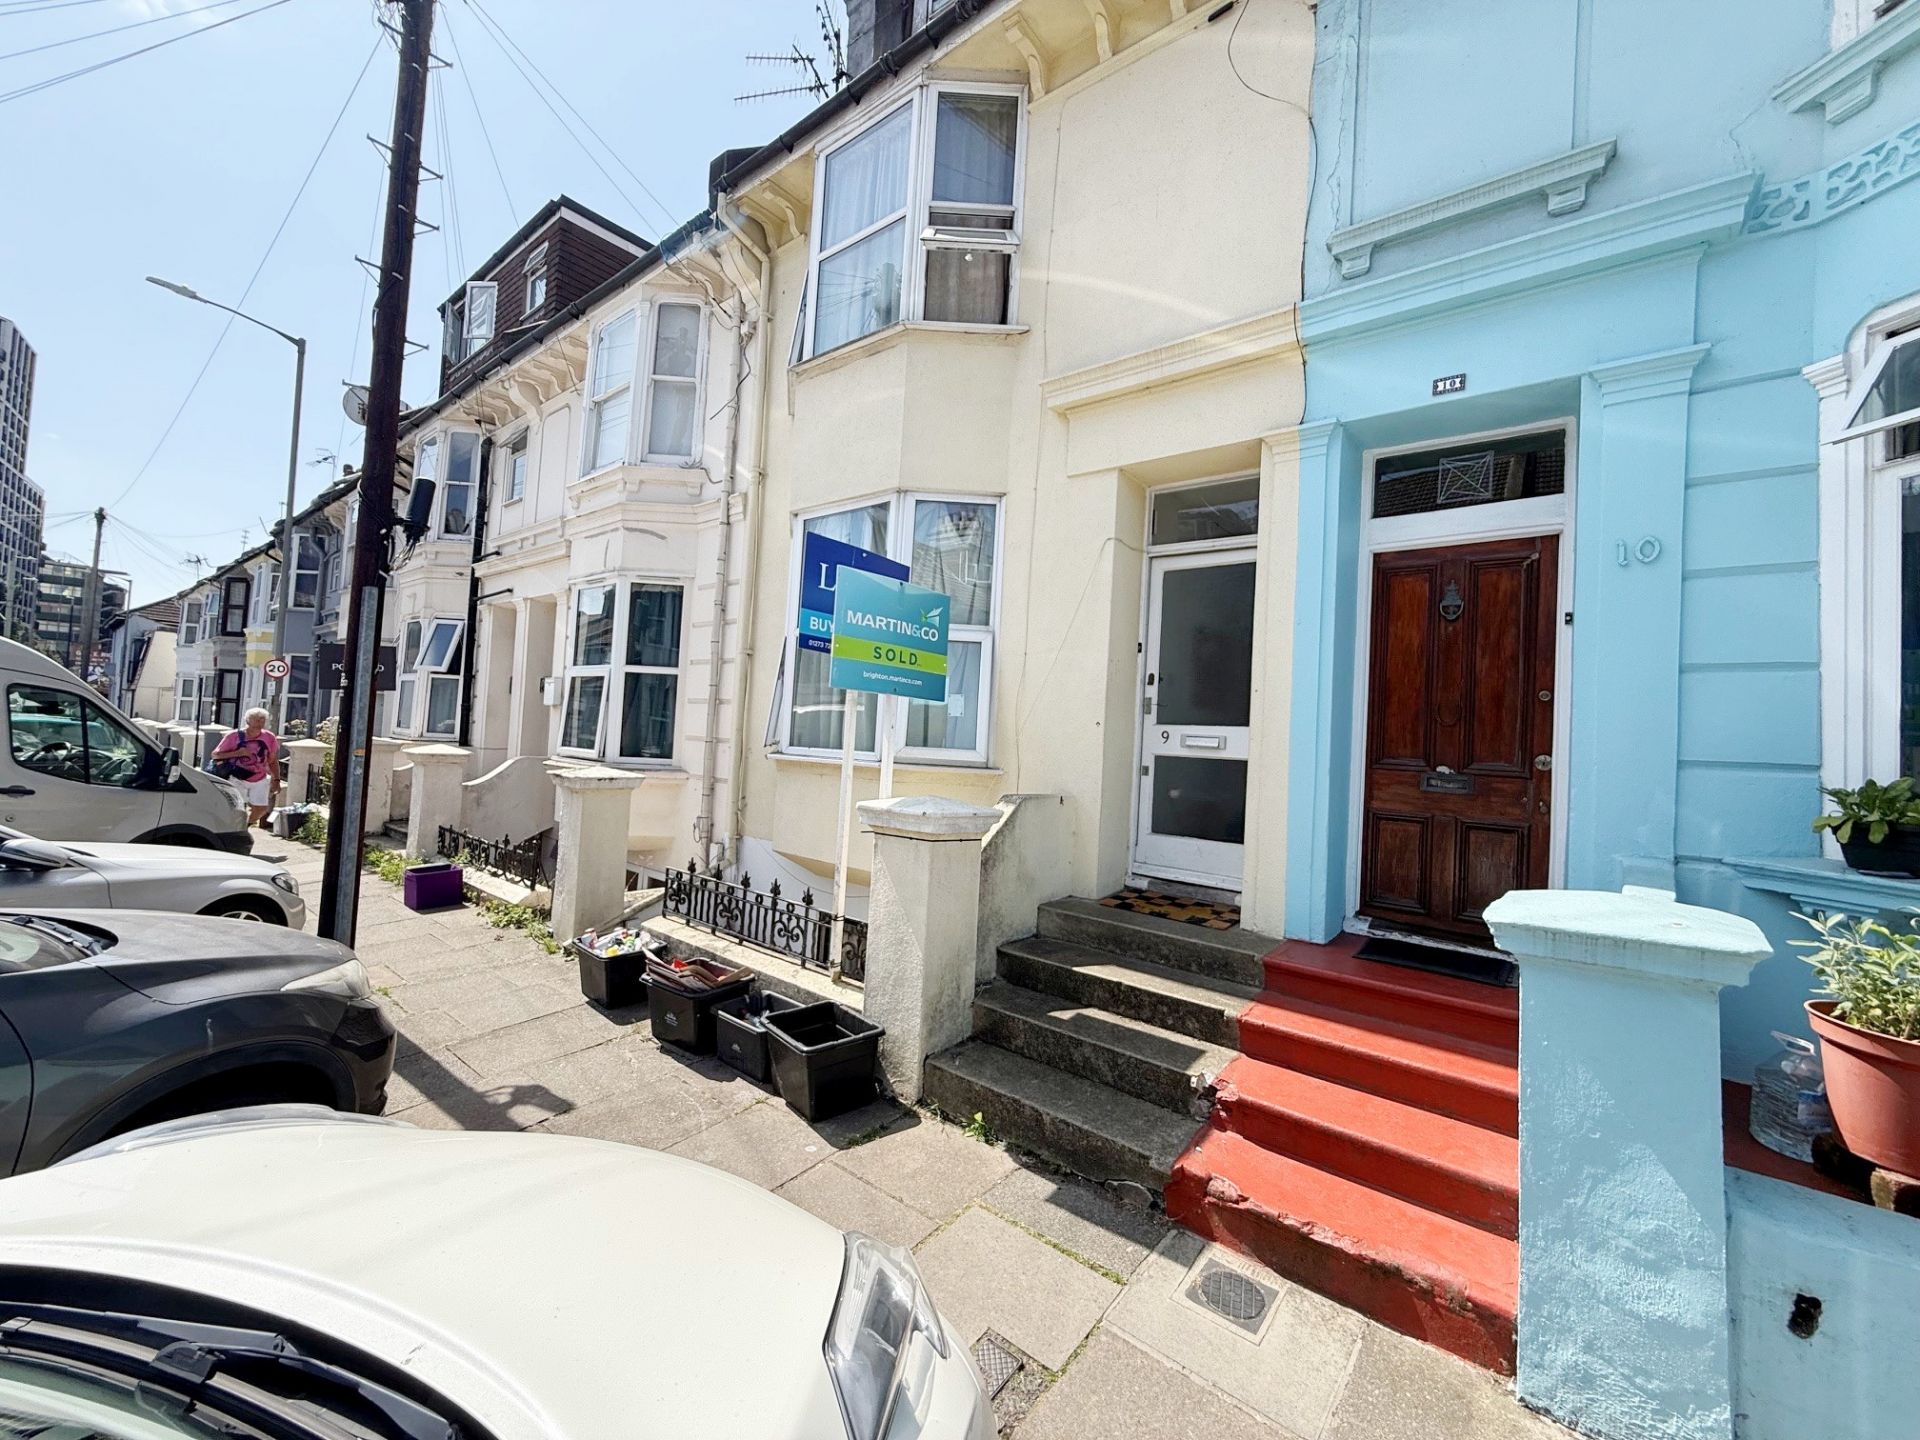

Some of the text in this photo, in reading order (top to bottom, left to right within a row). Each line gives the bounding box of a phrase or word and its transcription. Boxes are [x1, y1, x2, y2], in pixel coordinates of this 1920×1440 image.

[1443, 379, 1456, 390] 10
[1616, 535, 1661, 567] 10
[846, 609, 939, 642] MARTIN&CO
[873, 646, 918, 665] SOLD
[268, 664, 286, 673] 20
[1161, 730, 1170, 745] 9
